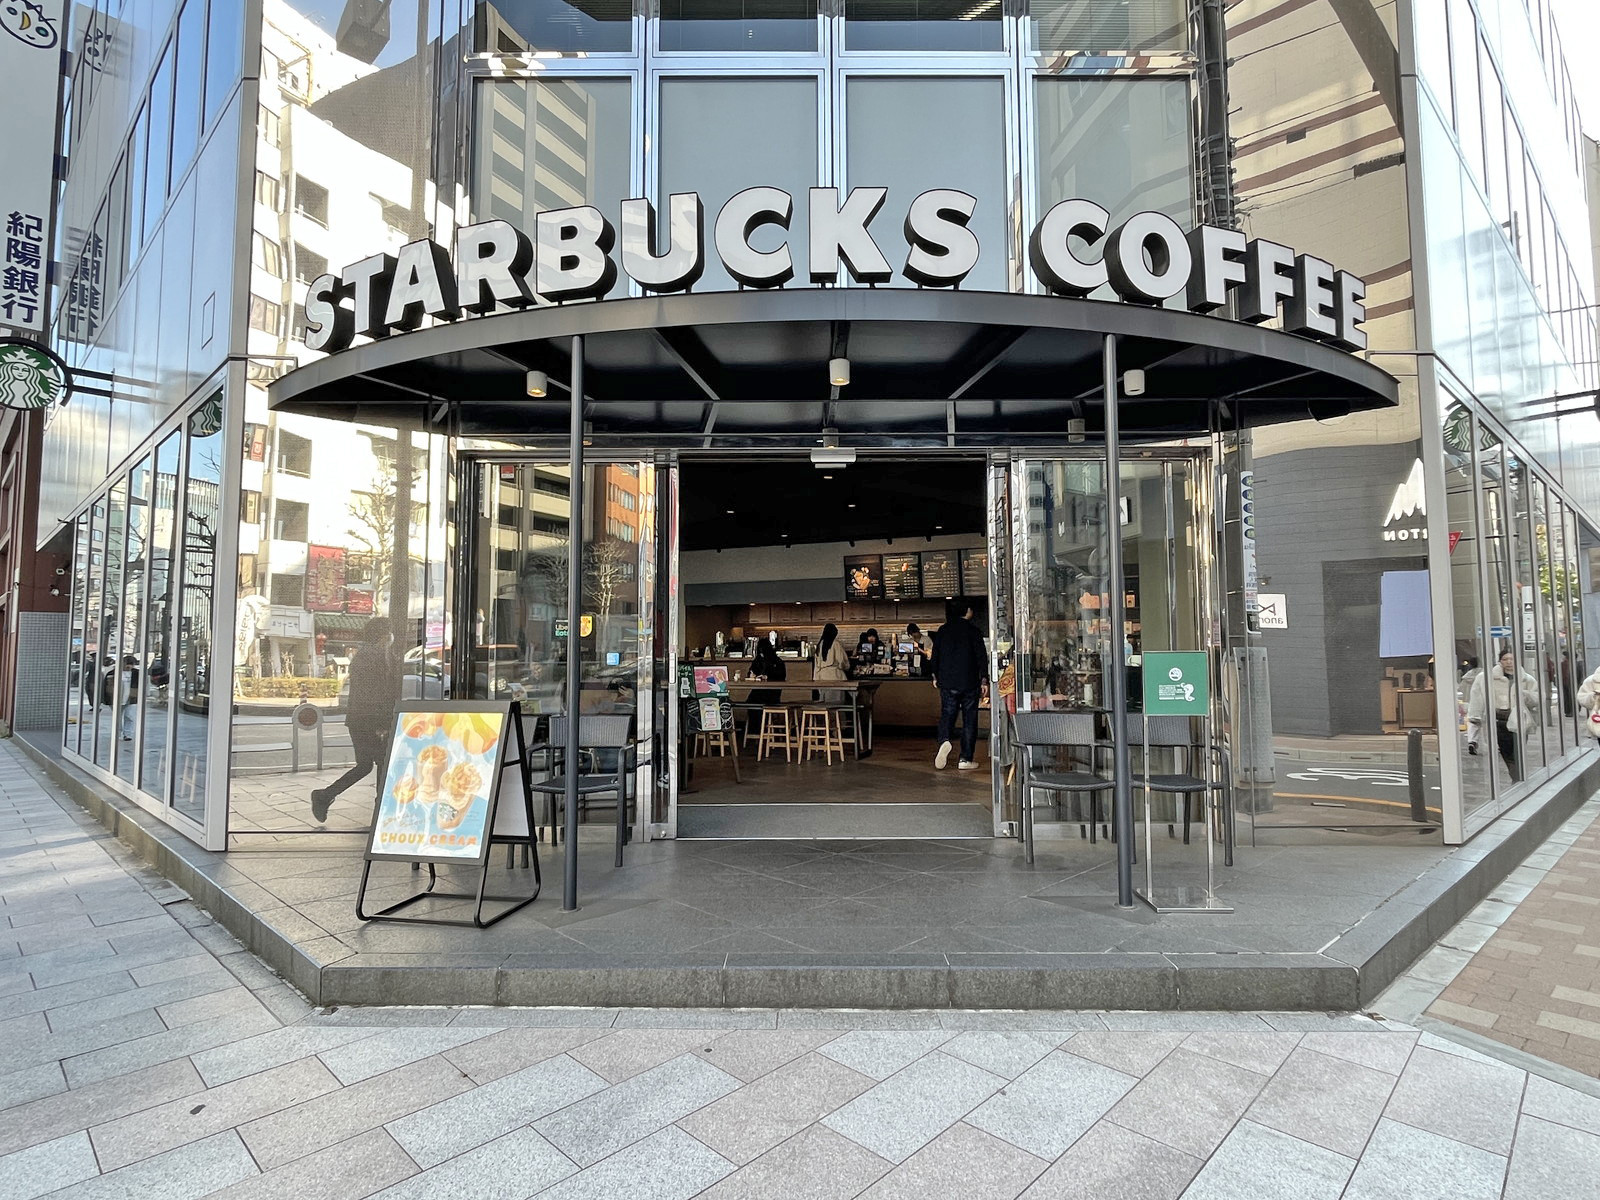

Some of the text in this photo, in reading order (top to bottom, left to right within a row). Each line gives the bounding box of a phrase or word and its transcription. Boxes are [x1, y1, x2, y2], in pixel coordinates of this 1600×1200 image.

[1, 211, 43, 323] 紀陽銀行
[305, 186, 1367, 353] STARBUCKS COFFEE
[380, 832, 477, 845] CHOUX CREAM
